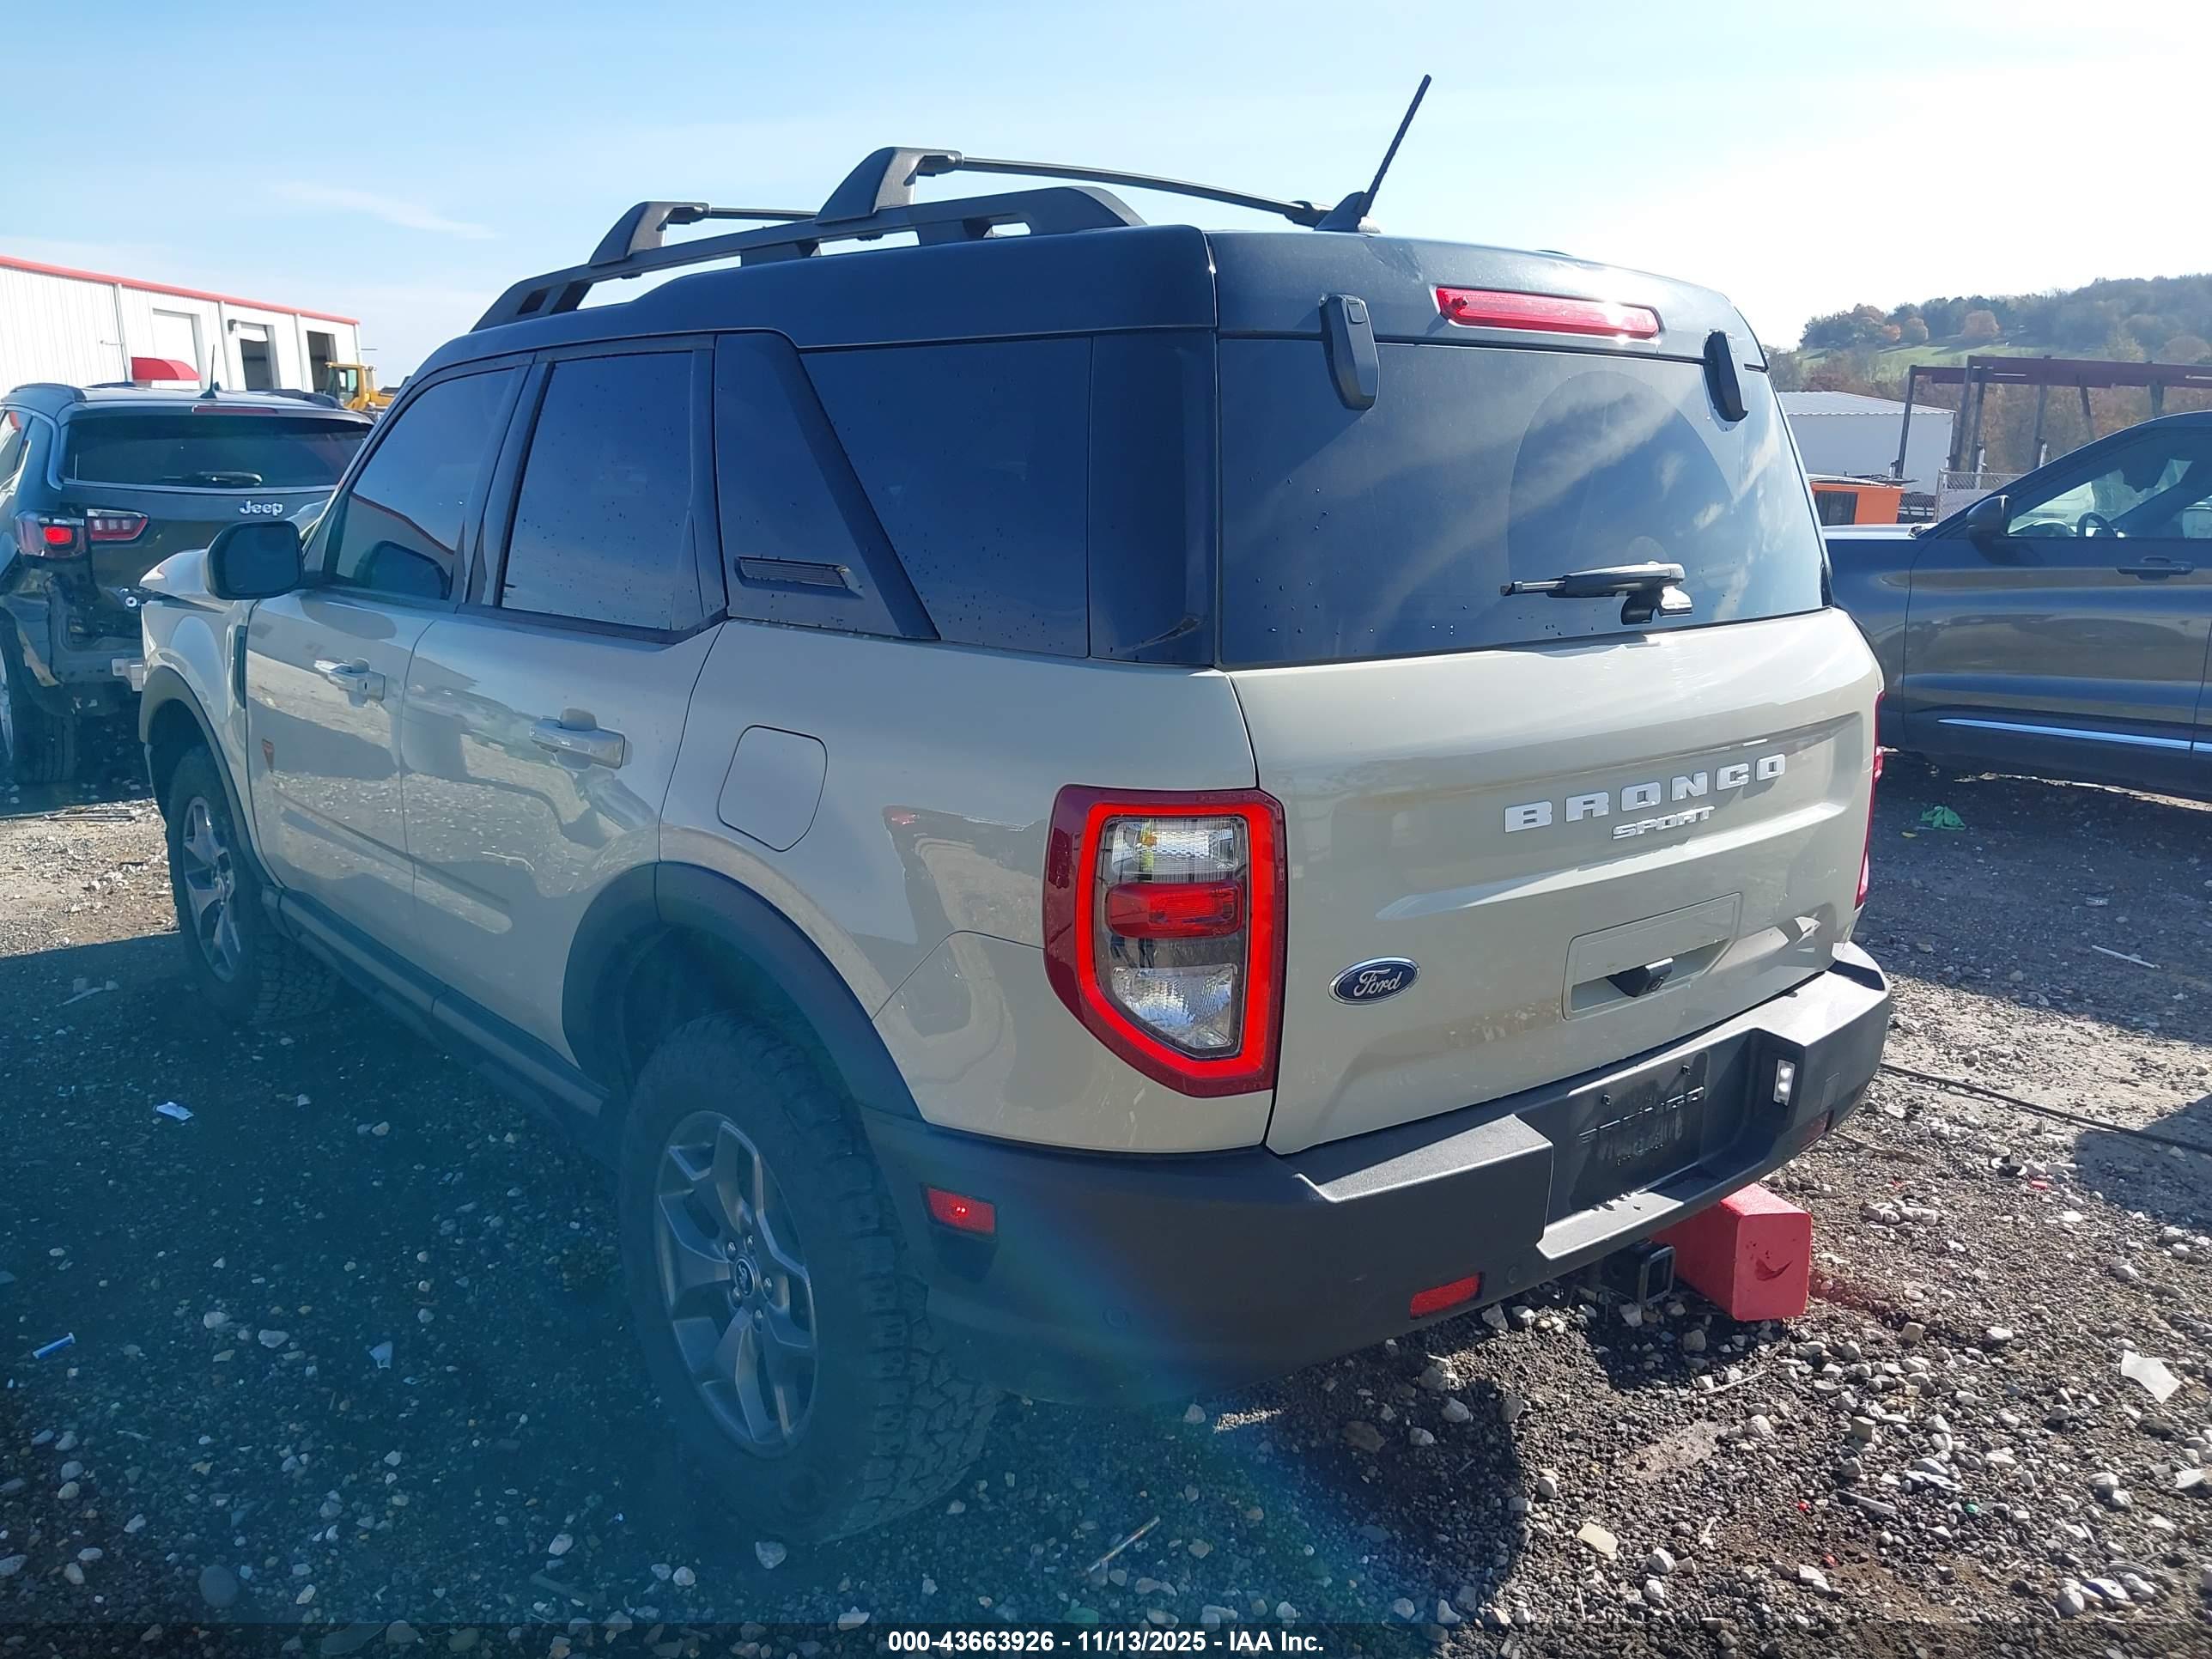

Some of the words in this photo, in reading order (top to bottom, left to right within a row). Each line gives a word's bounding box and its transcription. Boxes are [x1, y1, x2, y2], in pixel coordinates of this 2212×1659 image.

[239, 500, 283, 516] Jeep
[1504, 753, 1786, 833] BRONCO
[1612, 805, 1715, 840] SPORT
[1353, 968, 1403, 997] Ford
